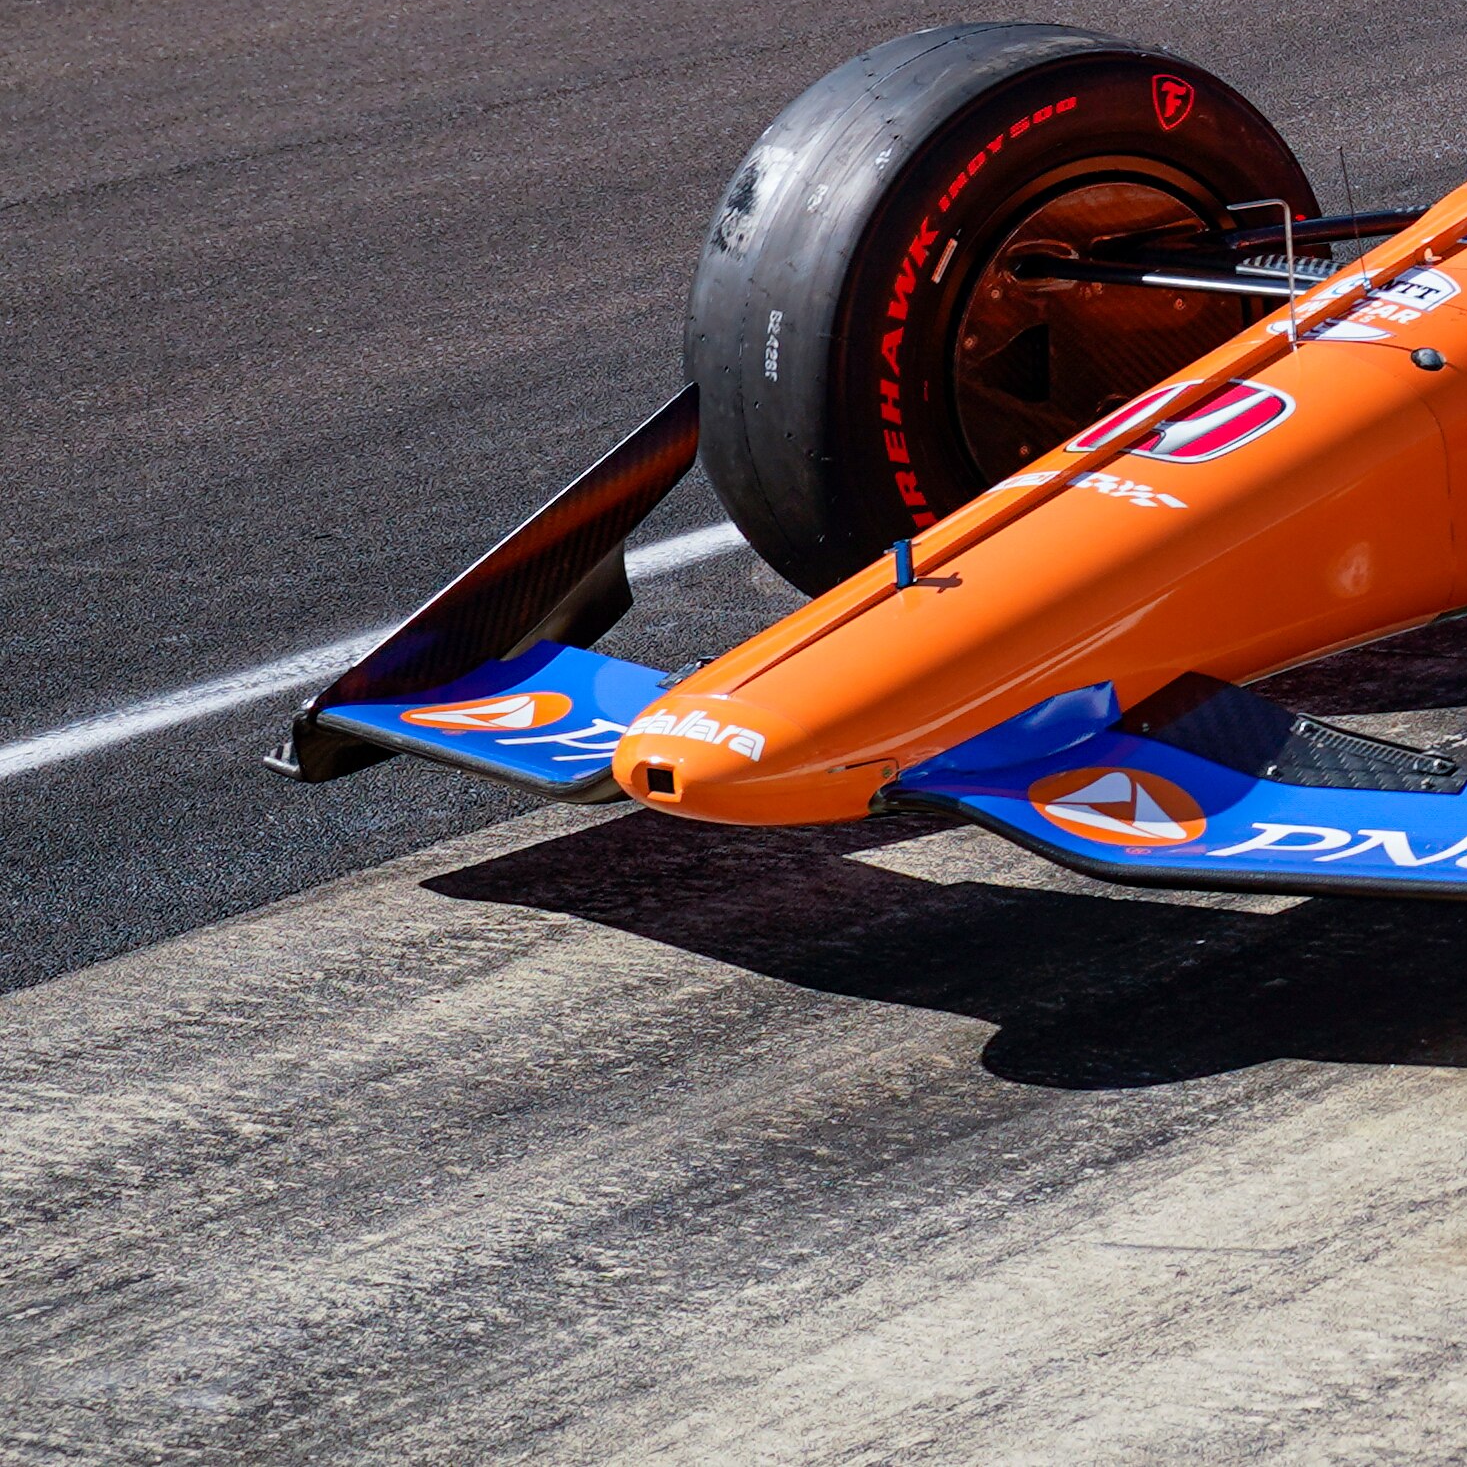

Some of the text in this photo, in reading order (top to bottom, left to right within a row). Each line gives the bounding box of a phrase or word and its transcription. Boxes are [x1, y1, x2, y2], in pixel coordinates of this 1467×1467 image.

[878, 95, 1079, 531] IREHAWK INDY 500
[1379, 280, 1440, 300] NTT
[625, 708, 766, 763] dallara
